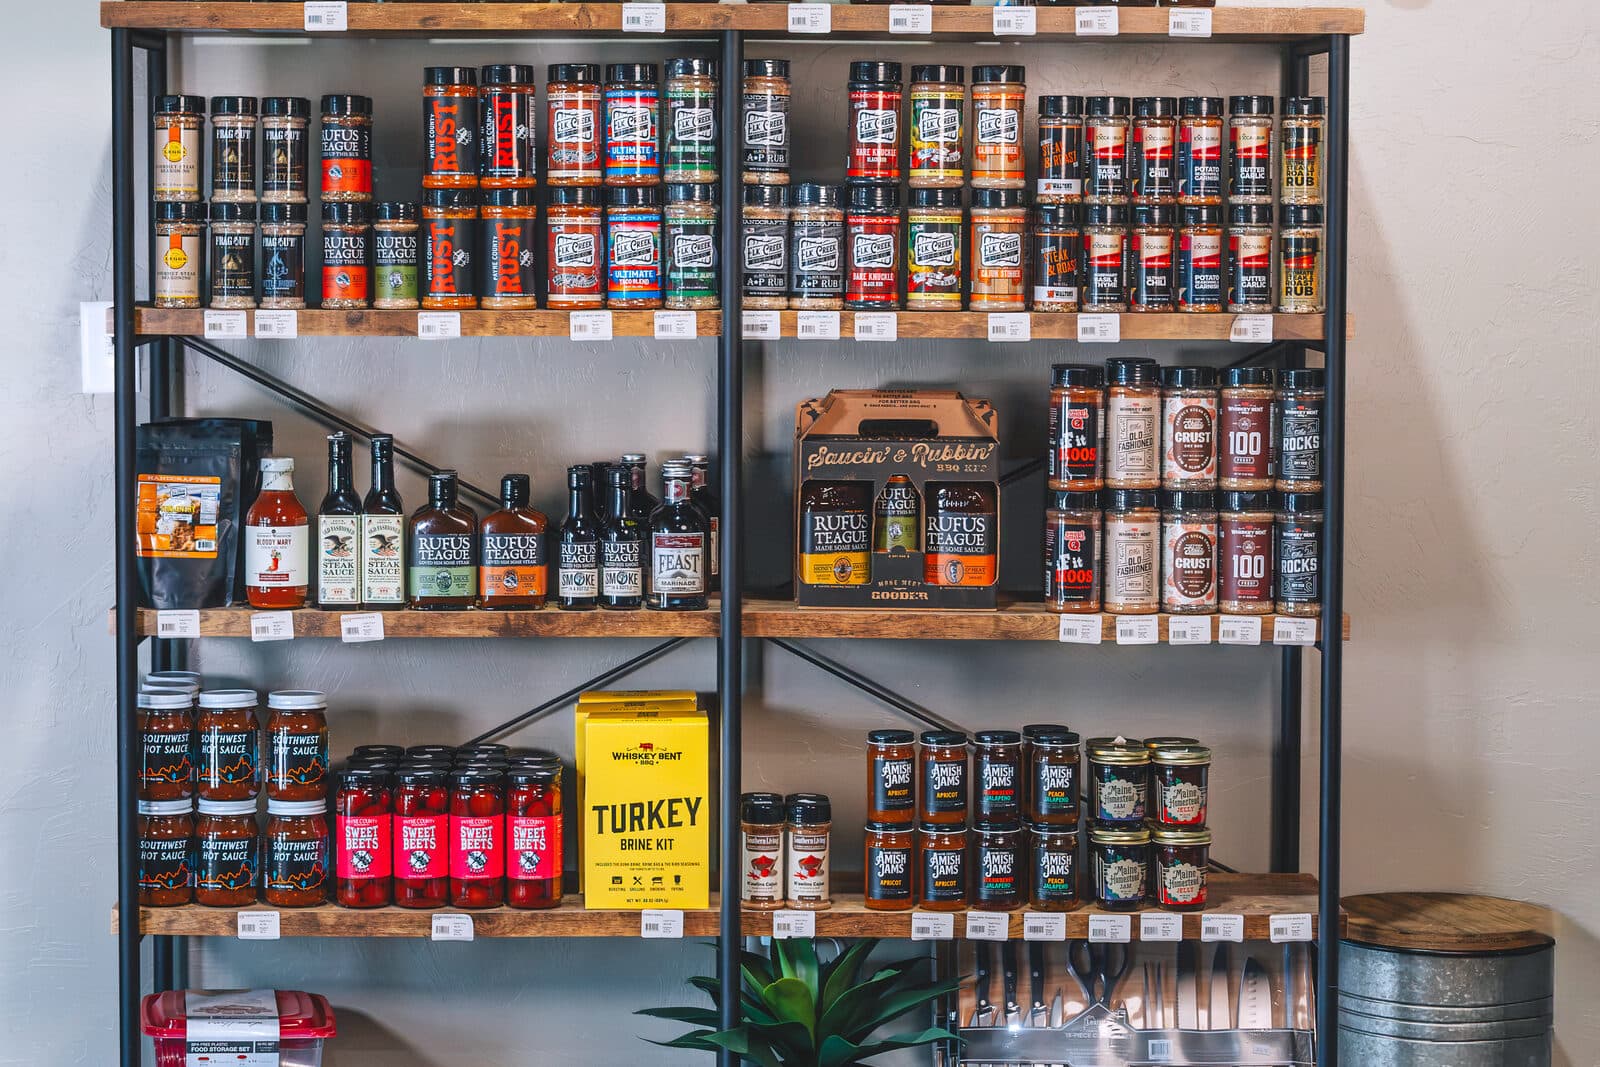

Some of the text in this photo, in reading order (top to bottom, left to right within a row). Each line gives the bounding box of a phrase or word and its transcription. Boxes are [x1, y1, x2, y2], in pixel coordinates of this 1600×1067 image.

[433, 101, 459, 171] RUST
[493, 96, 518, 168] RUST
[612, 146, 651, 154] ULTIMATE
[1286, 178, 1314, 186] RUB
[325, 237, 364, 248] RUFUS
[377, 237, 416, 248] RUFUS
[558, 241, 592, 256] ELK CREEK
[617, 240, 651, 255] ELK CREEK
[678, 241, 711, 256] ELK CREEK
[918, 240, 951, 256] ELK CREEK
[984, 240, 1018, 256] ELK CREEK
[325, 249, 364, 259] TEAGUE
[377, 249, 416, 259] TEAGUE
[748, 243, 782, 257] ELK CREEK
[801, 245, 836, 259] ELK CREEK
[857, 241, 891, 257] ELK CREEK
[430, 222, 456, 293] RUST
[496, 223, 522, 293] RUST
[1044, 249, 1068, 263] STEAK
[615, 270, 653, 278] ULTIMATE
[1286, 287, 1313, 296] RUB
[1129, 431, 1143, 440] OLD
[1175, 432, 1211, 443] CRUST
[1119, 438, 1153, 451] FASHIONED
[1229, 432, 1261, 455] 100
[1283, 436, 1319, 451] ROCKS
[808, 443, 994, 470] Saucin' & Rubbin'
[814, 515, 868, 531] RUFUS
[928, 517, 985, 531] RUFUS
[419, 538, 470, 549] RUFUS
[486, 537, 537, 549] RUFUS
[814, 532, 867, 544] TEAGUE
[928, 532, 985, 546] TEAGUE
[486, 549, 537, 559] TEAGUE
[561, 545, 596, 554] RUFUS
[605, 543, 639, 554] RUFUS
[419, 550, 470, 560] TEAGUE
[561, 555, 596, 563] TEAGUE
[605, 554, 639, 562] TEAGUE
[658, 554, 699, 573] FEAST
[1128, 557, 1142, 566] OLD
[1176, 558, 1211, 568] CRUST
[1233, 555, 1264, 578] 100
[1282, 558, 1317, 573] ROCKS
[1117, 562, 1152, 576] FASHIONED
[562, 572, 595, 586] SMOKE
[606, 571, 638, 585] SMOKE
[143, 734, 190, 743] SOUTHWEST
[201, 734, 247, 743] SOUTHWEST
[273, 735, 319, 744] SOUTHWEST
[144, 744, 189, 753] HOT SAUCE
[202, 744, 246, 754] HOT SAUCE
[274, 745, 318, 754] HOT SAUCE
[612, 752, 682, 760] WHISKEY BENT
[882, 762, 912, 777] AMISH
[931, 764, 962, 778] AMISH
[982, 764, 1014, 778] AMISH
[1040, 765, 1072, 779] AMISH
[885, 774, 910, 788] JAMS
[933, 776, 960, 790] JAMS
[985, 776, 1011, 790] JAMS
[1044, 778, 1070, 791] JAMS
[1108, 786, 1132, 797] Maine
[1173, 788, 1197, 799] Maine
[1103, 794, 1135, 804] Homestead
[1169, 798, 1200, 807] Homestead
[592, 797, 702, 834] TURKEY
[346, 825, 378, 838] SWEET
[403, 825, 436, 838] SWEET
[460, 826, 493, 838] SWEET
[514, 826, 546, 838] SWEET
[140, 840, 187, 850] SOUTHWEST
[202, 841, 248, 850] SOUTHWEST
[273, 841, 320, 850] SOUTHWEST
[346, 838, 378, 850] BEETS
[403, 838, 436, 850] BEETS
[460, 838, 493, 851] BEETS
[514, 838, 546, 851] BEETS
[620, 839, 674, 850] BRINE KIT
[141, 851, 185, 860] HOT SAUCE
[203, 851, 248, 860] HOT SAUCE
[274, 851, 318, 861] HOT SAUCE
[875, 852, 906, 865] AMISH
[929, 852, 960, 866] AMISH
[982, 852, 1014, 865] AMISH
[1040, 852, 1072, 866] AMISH
[878, 863, 904, 878] JAMS
[932, 865, 959, 879] JAMS
[985, 863, 1011, 878] JAMS
[1044, 864, 1069, 878] JAMS
[1114, 866, 1137, 877] Maine
[1173, 869, 1196, 880] Maine
[1109, 874, 1140, 884] Homestead
[1168, 878, 1199, 888] Homestead
